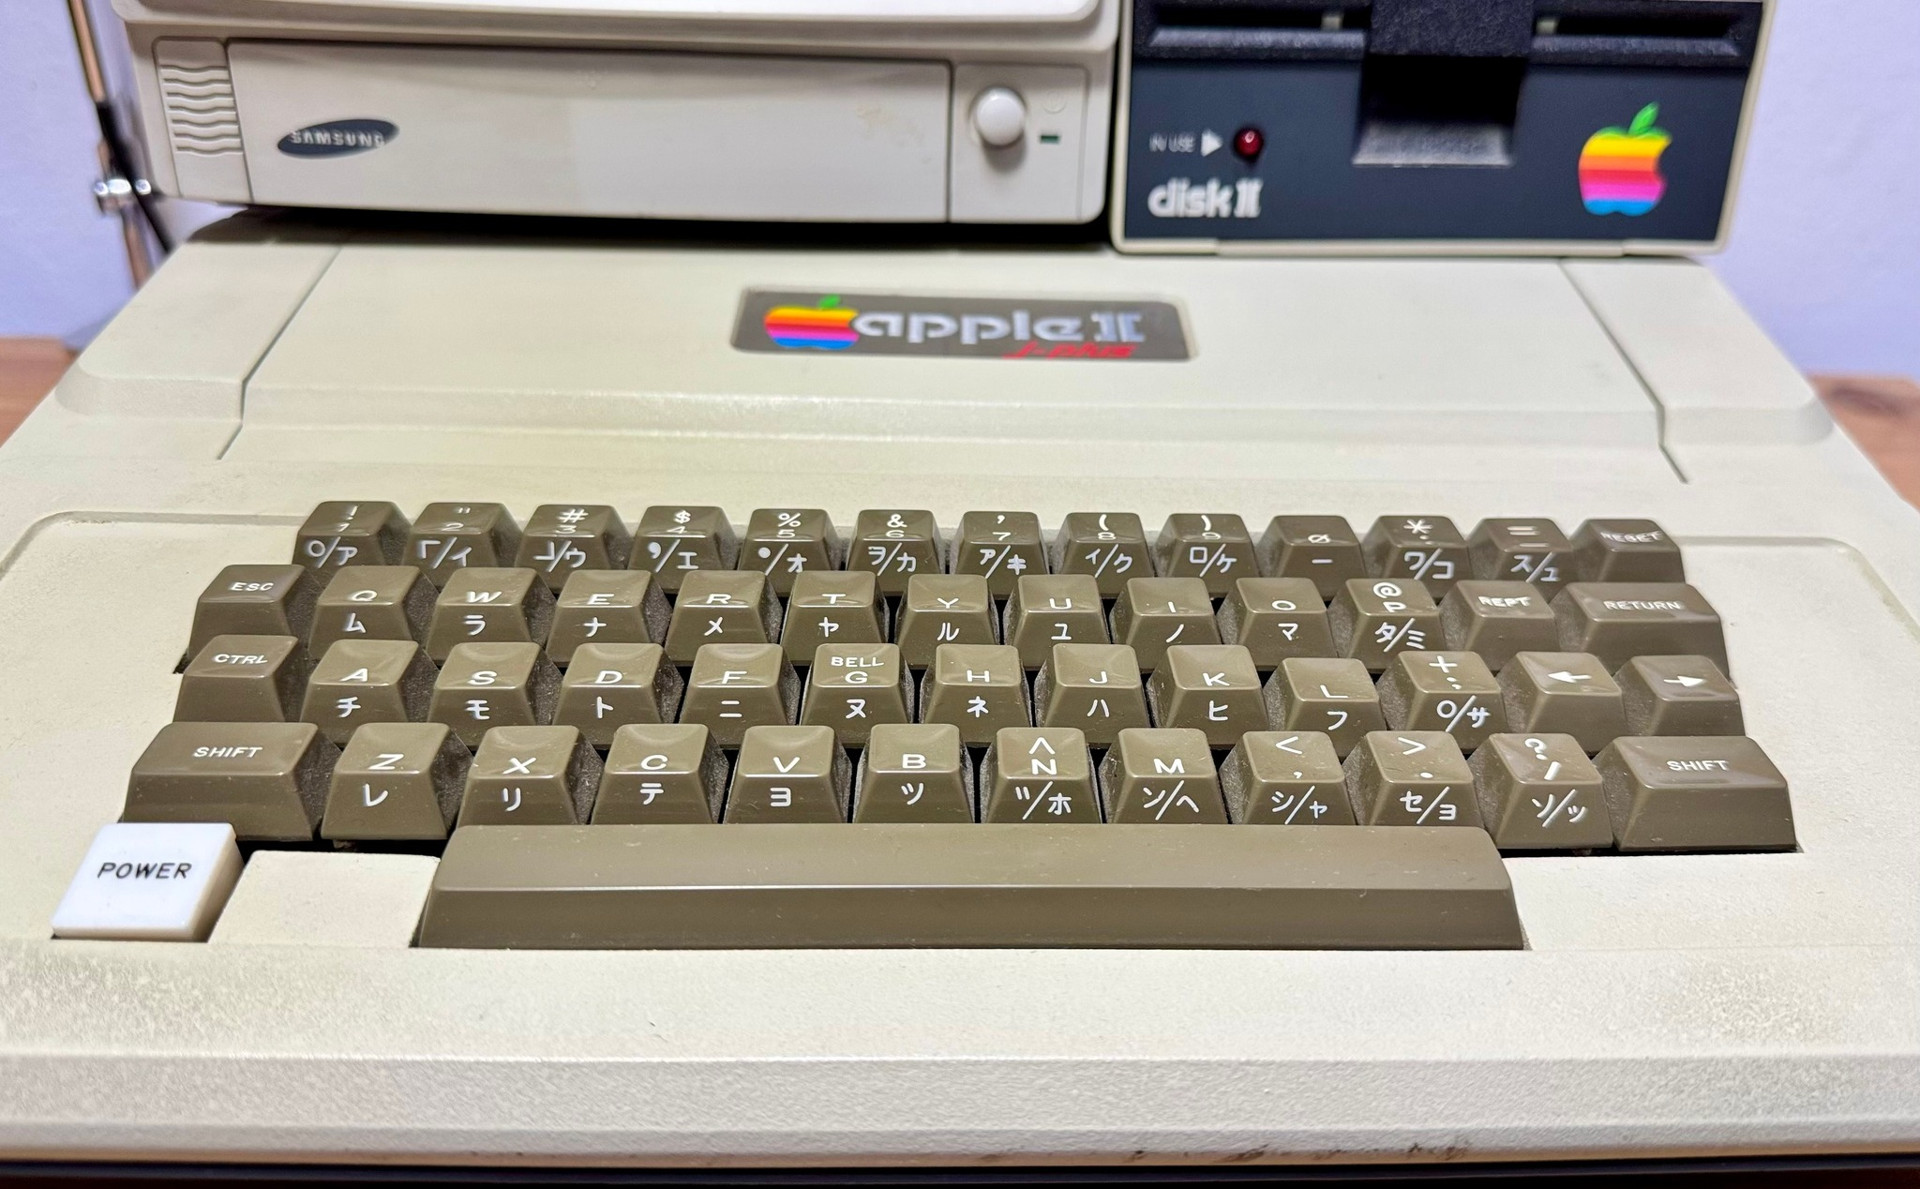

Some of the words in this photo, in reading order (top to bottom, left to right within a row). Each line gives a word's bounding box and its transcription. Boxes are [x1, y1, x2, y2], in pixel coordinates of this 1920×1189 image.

[1168, 132, 1196, 152] USE
[1147, 177, 1234, 218] disk
[853, 309, 1084, 344] apple
[347, 505, 358, 520] !
[557, 508, 588, 523] #
[674, 509, 691, 524] $
[777, 512, 802, 527] %
[444, 522, 464, 532] 2
[886, 514, 908, 528] &
[1098, 513, 1110, 531] (
[1200, 514, 1212, 531] )
[555, 525, 578, 534] 3
[667, 525, 688, 534] 4
[776, 529, 796, 539] 5
[885, 529, 905, 539] 6
[992, 531, 1012, 541] 7
[1097, 531, 1117, 541] 8
[1201, 531, 1222, 541] 9
[1506, 526, 1541, 536] =
[231, 582, 275, 592] ESC
[1372, 581, 1403, 599] @
[351, 590, 378, 602] Q
[466, 590, 503, 603] W
[586, 593, 615, 605] E
[706, 593, 733, 605] R
[821, 593, 847, 605] T
[936, 597, 960, 609] Y
[1478, 595, 1532, 609] REPT
[1048, 598, 1073, 610] U
[1382, 601, 1408, 613] P
[1603, 600, 1683, 611] RETURN
[345, 613, 366, 634] ム
[464, 615, 487, 635] ラ
[583, 617, 607, 637] ナ
[704, 617, 724, 637] メ
[936, 622, 961, 642] ル
[1165, 623, 1185, 643] ノ
[1277, 623, 1299, 641] マ
[212, 653, 269, 665] CTRL
[830, 656, 885, 668] BELL
[1428, 655, 1459, 673] +
[340, 668, 369, 682] A
[468, 670, 498, 685] S
[595, 669, 624, 684] D
[721, 670, 748, 685] F
[844, 670, 868, 684] G
[966, 669, 990, 683] H
[1088, 671, 1107, 685] J
[1202, 672, 1231, 687] K
[1319, 684, 1349, 699] L
[336, 696, 361, 718] チ
[466, 699, 490, 720] モ
[596, 696, 614, 719] ト
[845, 698, 867, 720] ヌ
[966, 695, 989, 718] ネ
[1086, 699, 1110, 718] ハ
[1208, 700, 1229, 722] ヒ
[1326, 710, 1348, 731] フ
[193, 746, 264, 759] SHIFT
[1275, 736, 1304, 755] <
[1397, 736, 1427, 755] >
[1524, 737, 1548, 761] ?
[367, 753, 405, 771] Z
[502, 756, 538, 775] X
[640, 754, 669, 771] C
[773, 756, 801, 773] V
[901, 753, 927, 770] B
[1031, 758, 1058, 776] N
[1153, 758, 1185, 775] M
[1666, 760, 1730, 773] SHIFT
[362, 783, 389, 807] レ
[502, 786, 522, 812] リ
[639, 782, 665, 805] テ
[97, 862, 193, 880] POWER
